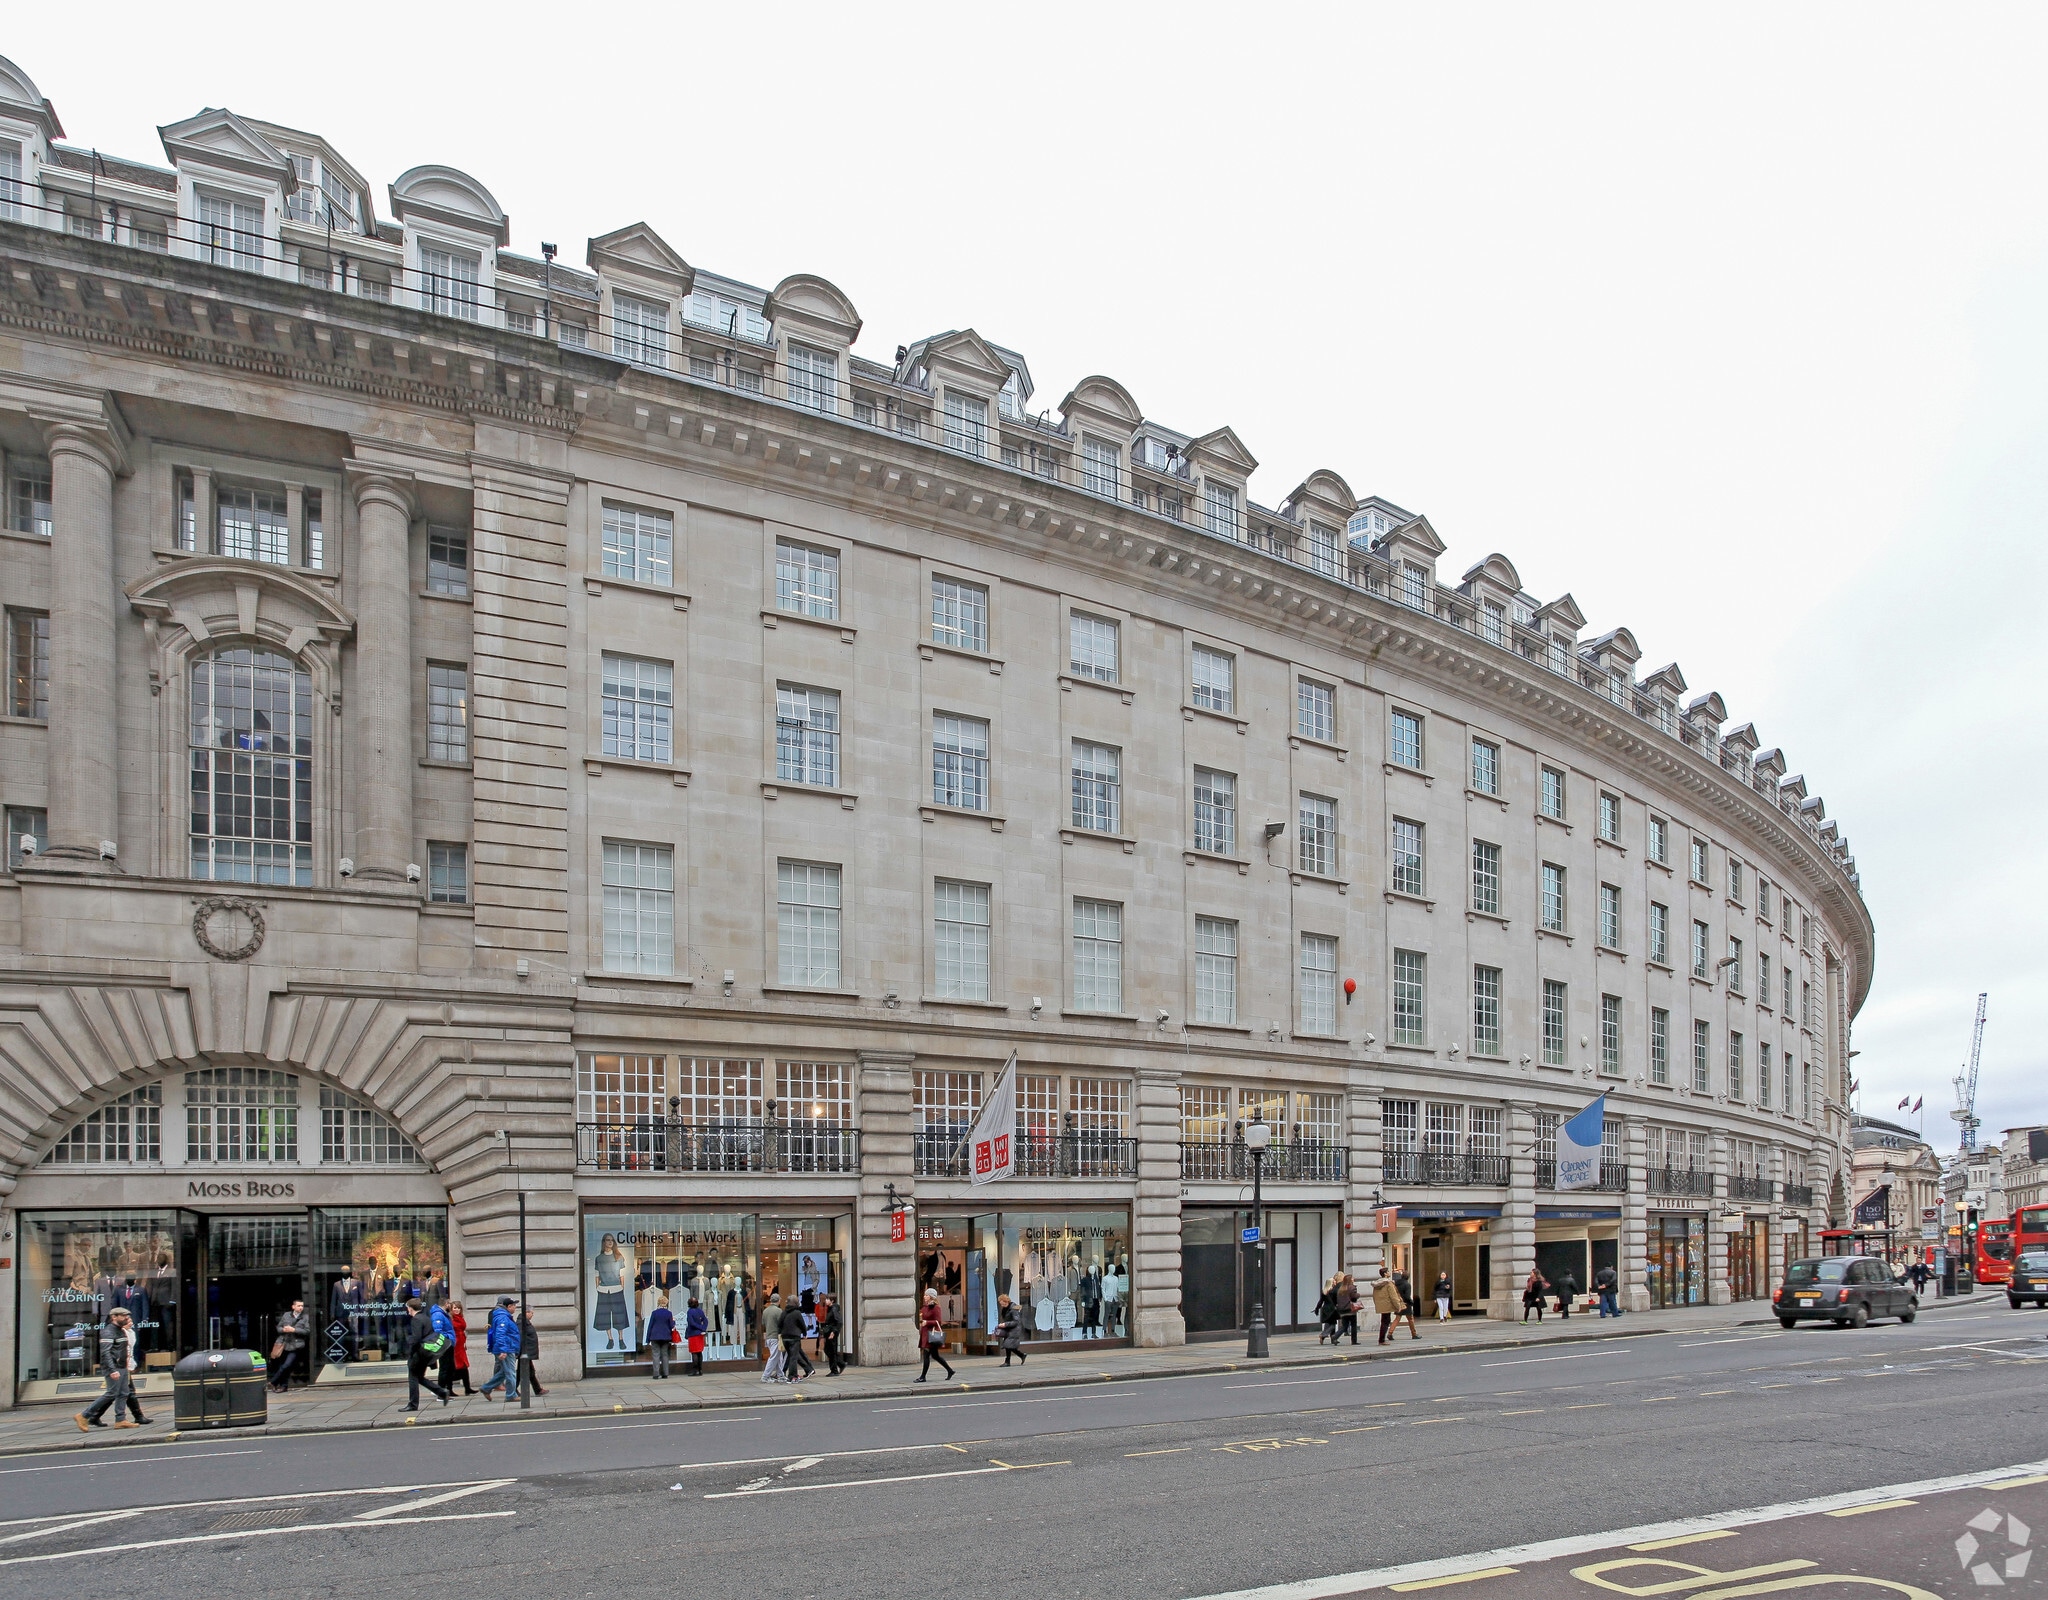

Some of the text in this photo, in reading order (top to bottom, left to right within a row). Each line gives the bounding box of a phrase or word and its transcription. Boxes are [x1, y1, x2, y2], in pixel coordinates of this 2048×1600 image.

[1559, 1158, 1593, 1176] QUADRANT
[1562, 1171, 1590, 1183] ARCADE
[1656, 1199, 1695, 1209] STEFANEL
[616, 1230, 737, 1245] Clothes That Work
[1025, 1227, 1115, 1239] Clothes That Work
[41, 1293, 105, 1303] TAILORING
[341, 1302, 358, 1310] Your
[93, 1321, 106, 1330] off
[137, 1320, 160, 1328] shirts
[1210, 1437, 1330, 1454] TAXIS
